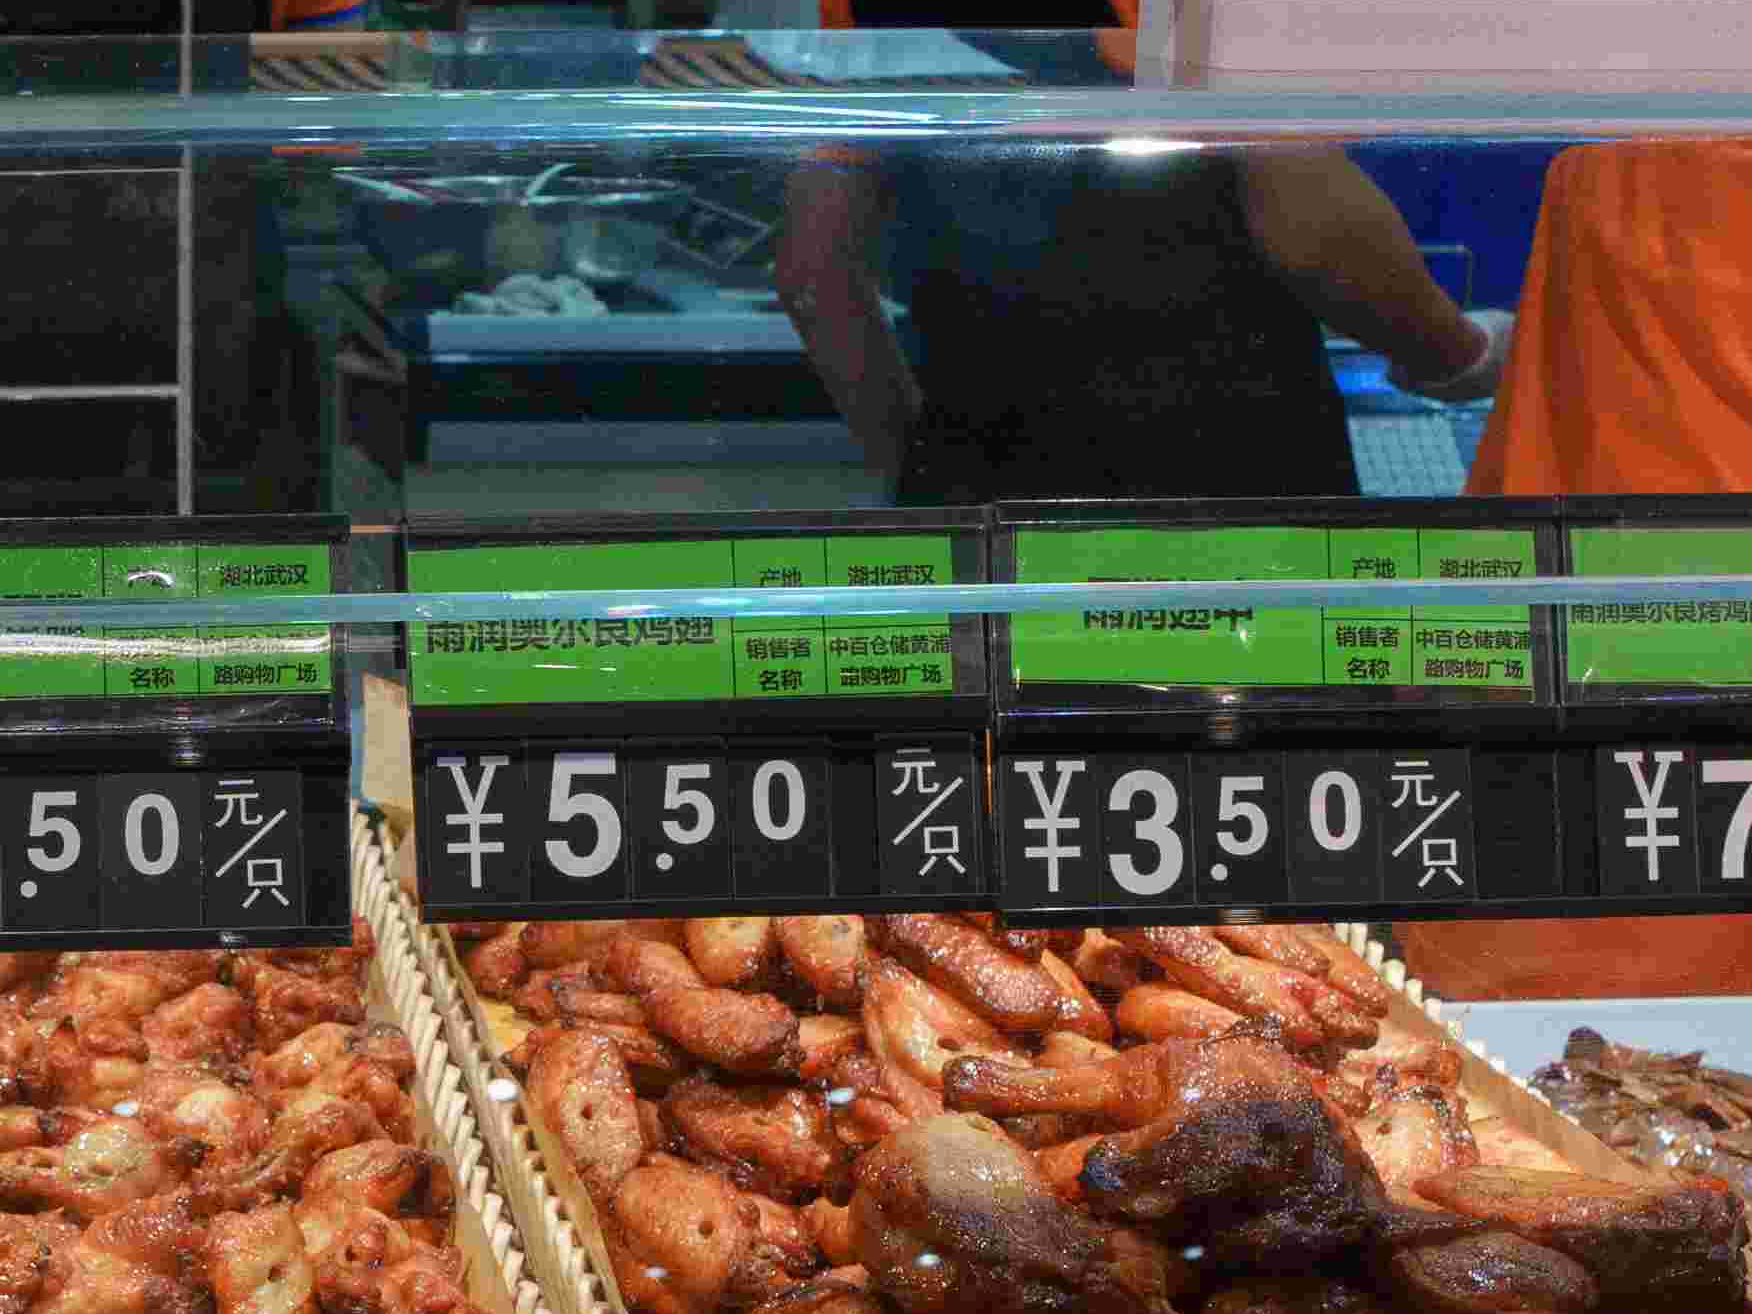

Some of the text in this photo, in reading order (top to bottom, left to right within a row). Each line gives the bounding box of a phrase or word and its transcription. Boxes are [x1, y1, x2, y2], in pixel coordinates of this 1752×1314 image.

[1336, 625, 1398, 648] 销售者
[747, 637, 811, 660] 销售者
[130, 666, 175, 689] 名称
[214, 662, 320, 685] 路购物广场
[760, 668, 803, 691] 名称
[1347, 657, 1390, 679] 名称
[436, 752, 806, 887] ¥5.50
[1014, 760, 1362, 895] ¥3.50
